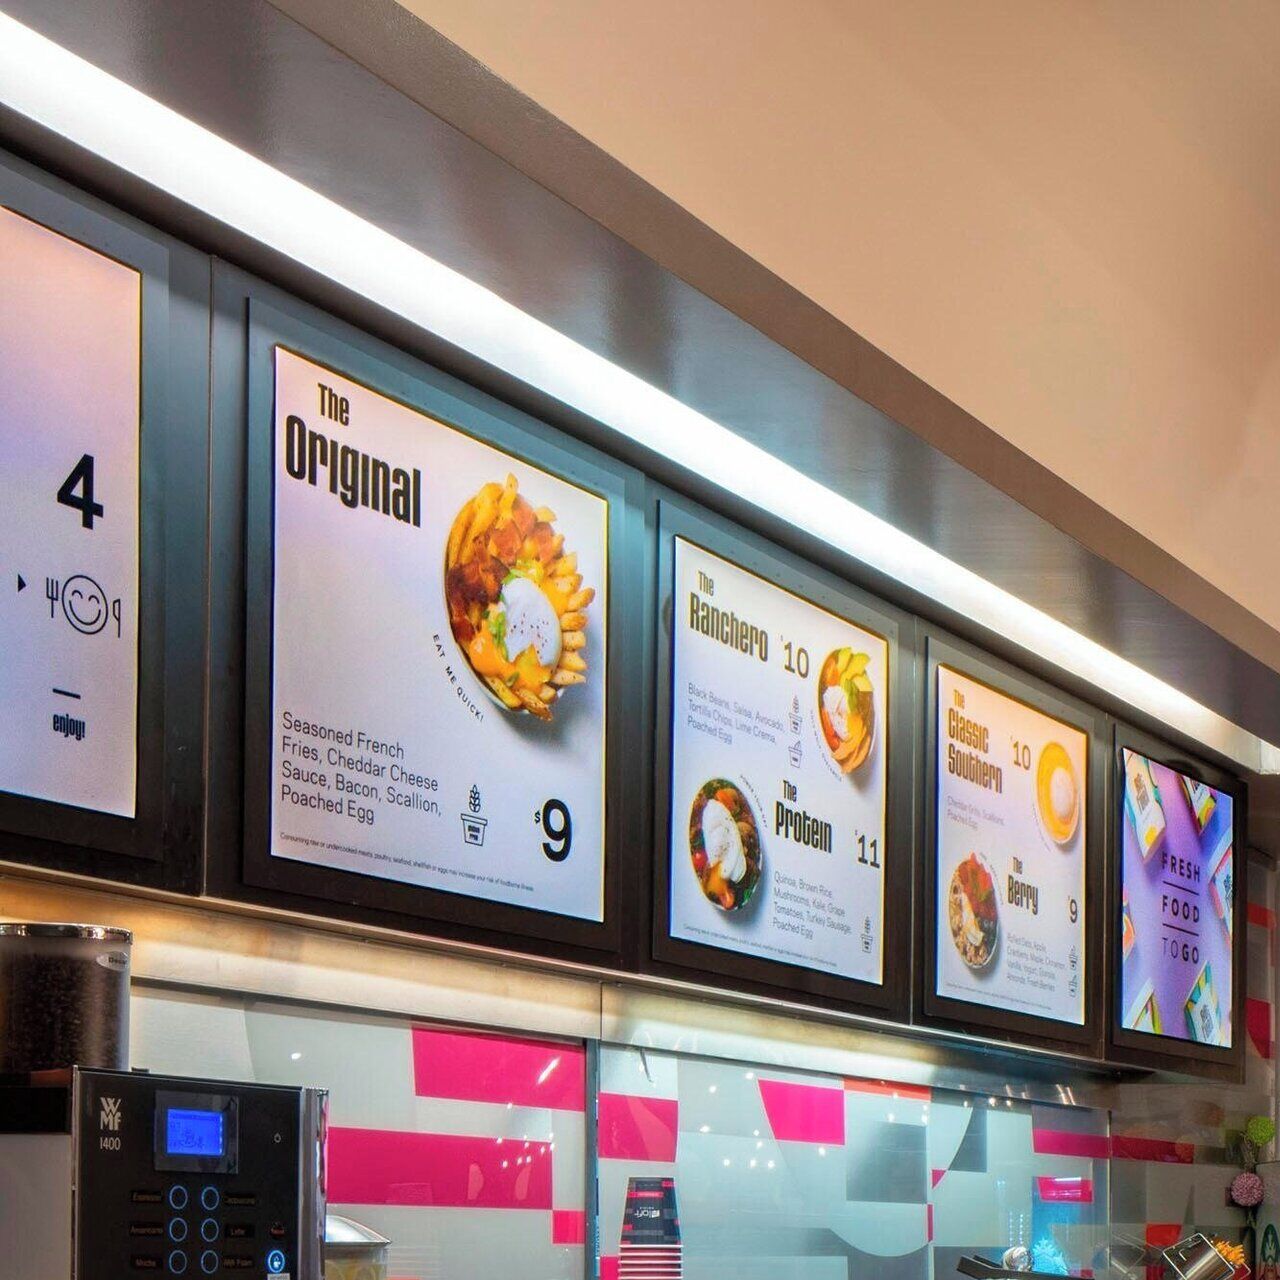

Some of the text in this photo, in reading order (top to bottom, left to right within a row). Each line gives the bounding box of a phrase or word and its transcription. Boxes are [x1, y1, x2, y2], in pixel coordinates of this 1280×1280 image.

[317, 383, 350, 426] The
[57, 453, 104, 530] 4
[286, 414, 421, 528] Original
[698, 570, 715, 596] The
[690, 591, 768, 662] Ranchero
[433, 634, 484, 722] EAT ME QUICK!
[781, 634, 810, 679] 10
[954, 689, 965, 709] The
[53, 713, 86, 741] enjoy!
[282, 711, 404, 760] Seasoned French
[948, 708, 989, 754] Classic
[282, 735, 438, 792] Fries, Cheddar Cheese
[948, 743, 1003, 794] Southern
[1010, 735, 1031, 770] 10
[281, 784, 374, 825] Poached Egg
[282, 760, 442, 817] Sauce, Bacon, Scallion,
[783, 780, 797, 802] The
[534, 798, 573, 863] $9
[776, 800, 832, 853] Protein
[1013, 856, 1023, 875] The
[1162, 853, 1200, 883] FRESH
[1007, 874, 1039, 915] Berry
[1068, 895, 1078, 924] 9
[1162, 895, 1200, 923] FOOD
[100, 1136, 121, 1151] 1400
